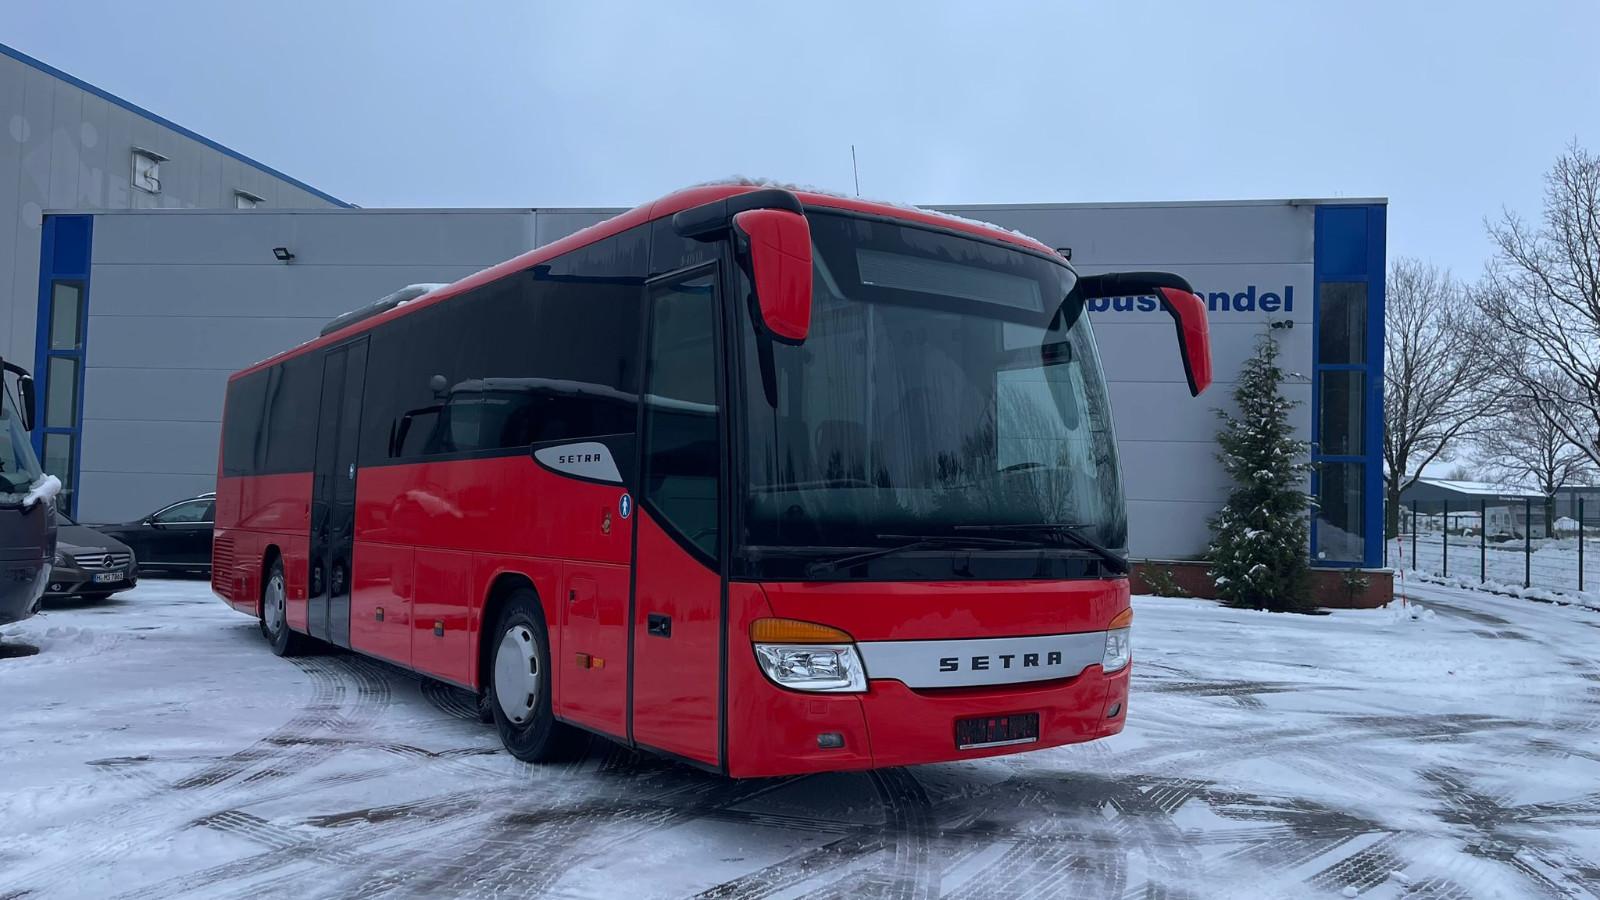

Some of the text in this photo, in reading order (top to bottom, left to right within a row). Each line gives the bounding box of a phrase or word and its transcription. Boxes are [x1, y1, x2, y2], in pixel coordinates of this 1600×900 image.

[1089, 286, 1294, 312] busndel
[559, 453, 601, 464] SETRA
[939, 651, 1062, 672] SETRA
